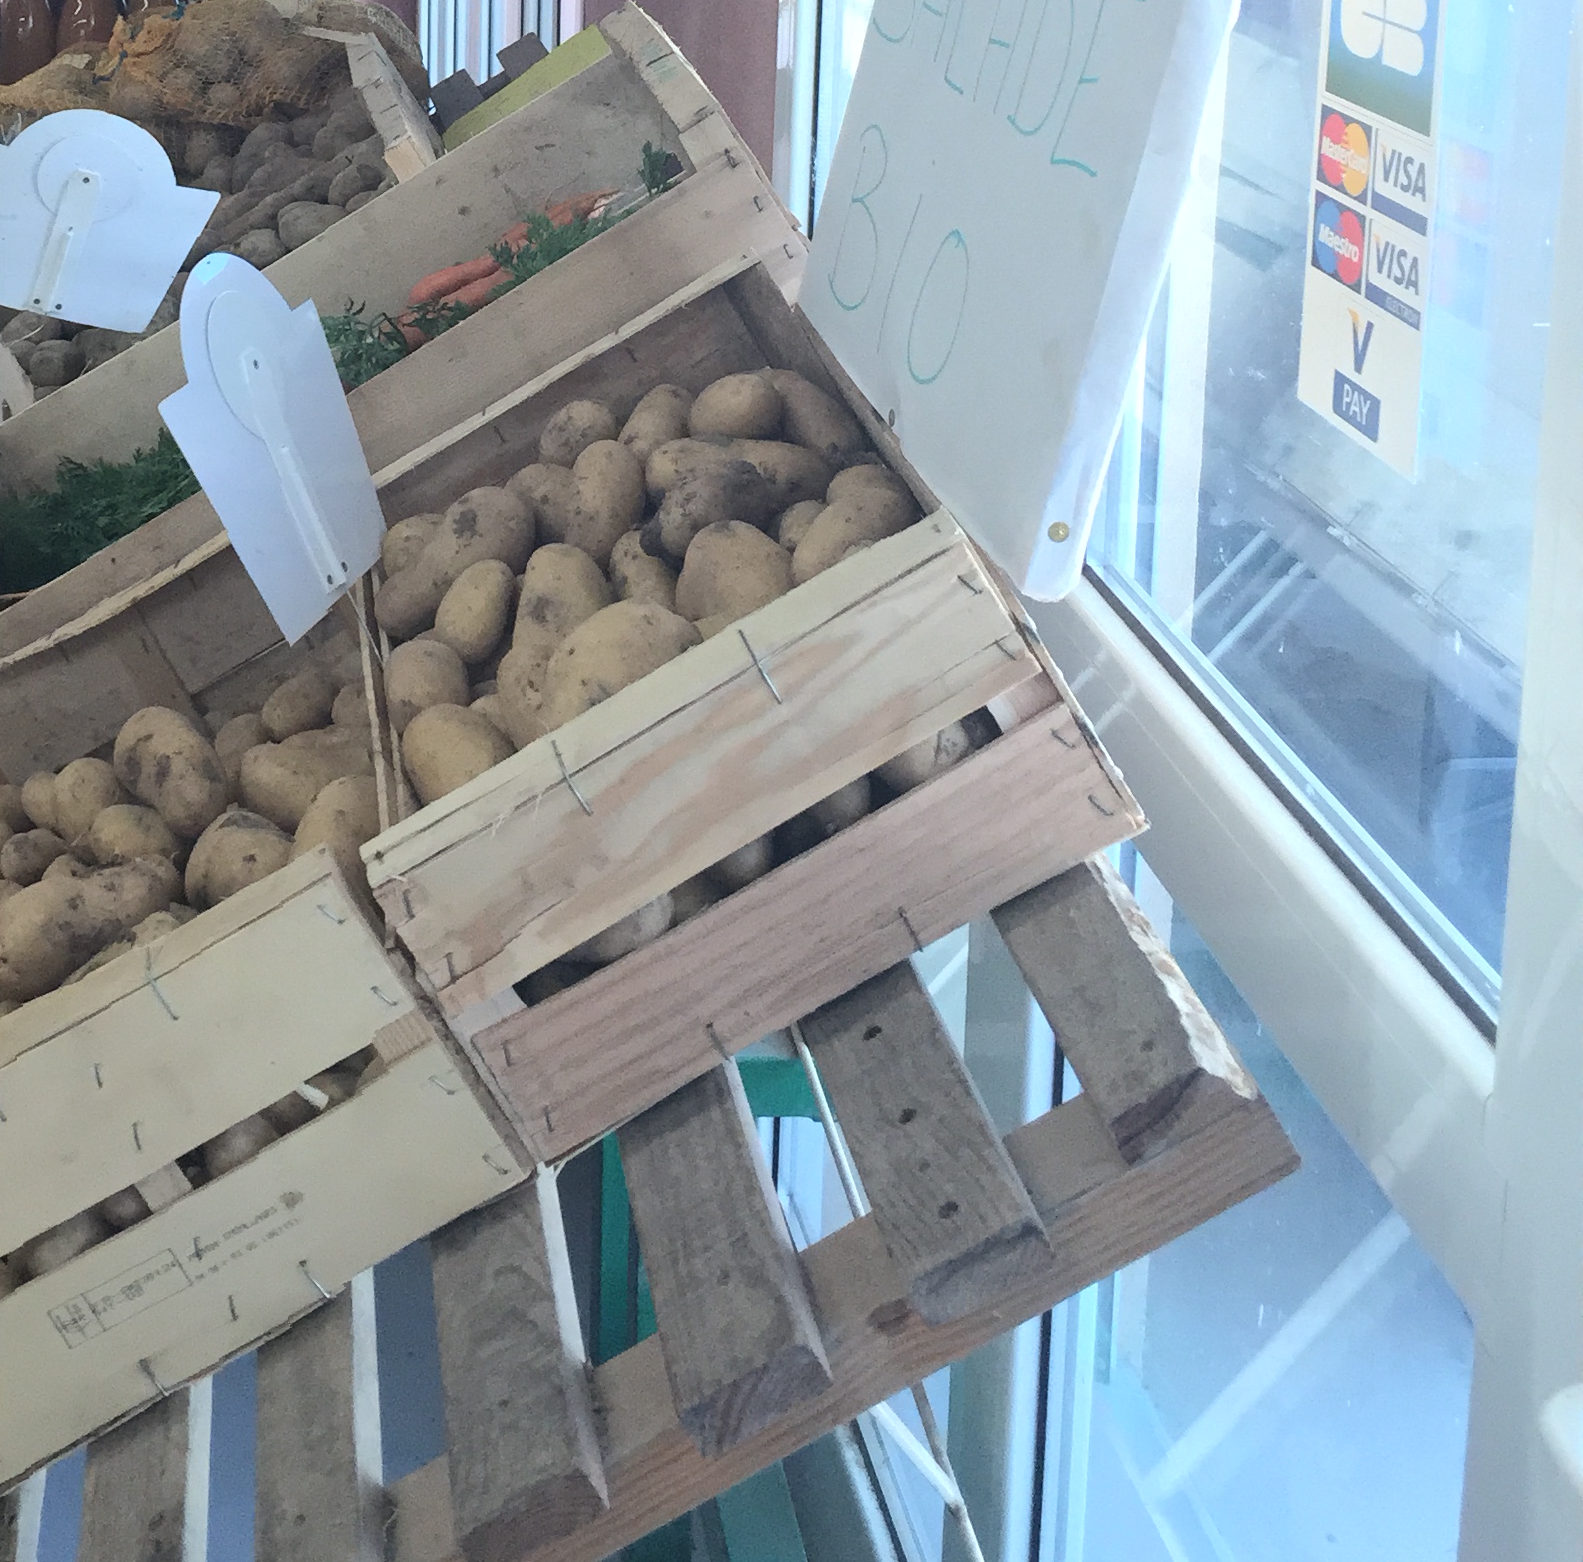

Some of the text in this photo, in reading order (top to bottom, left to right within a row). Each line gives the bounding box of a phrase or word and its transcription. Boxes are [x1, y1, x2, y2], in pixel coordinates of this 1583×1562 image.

[1380, 144, 1428, 203] VISA
[828, 123, 969, 385] BIO
[1318, 222, 1420, 296] Maestro VISA
[1341, 382, 1371, 428] PAY
